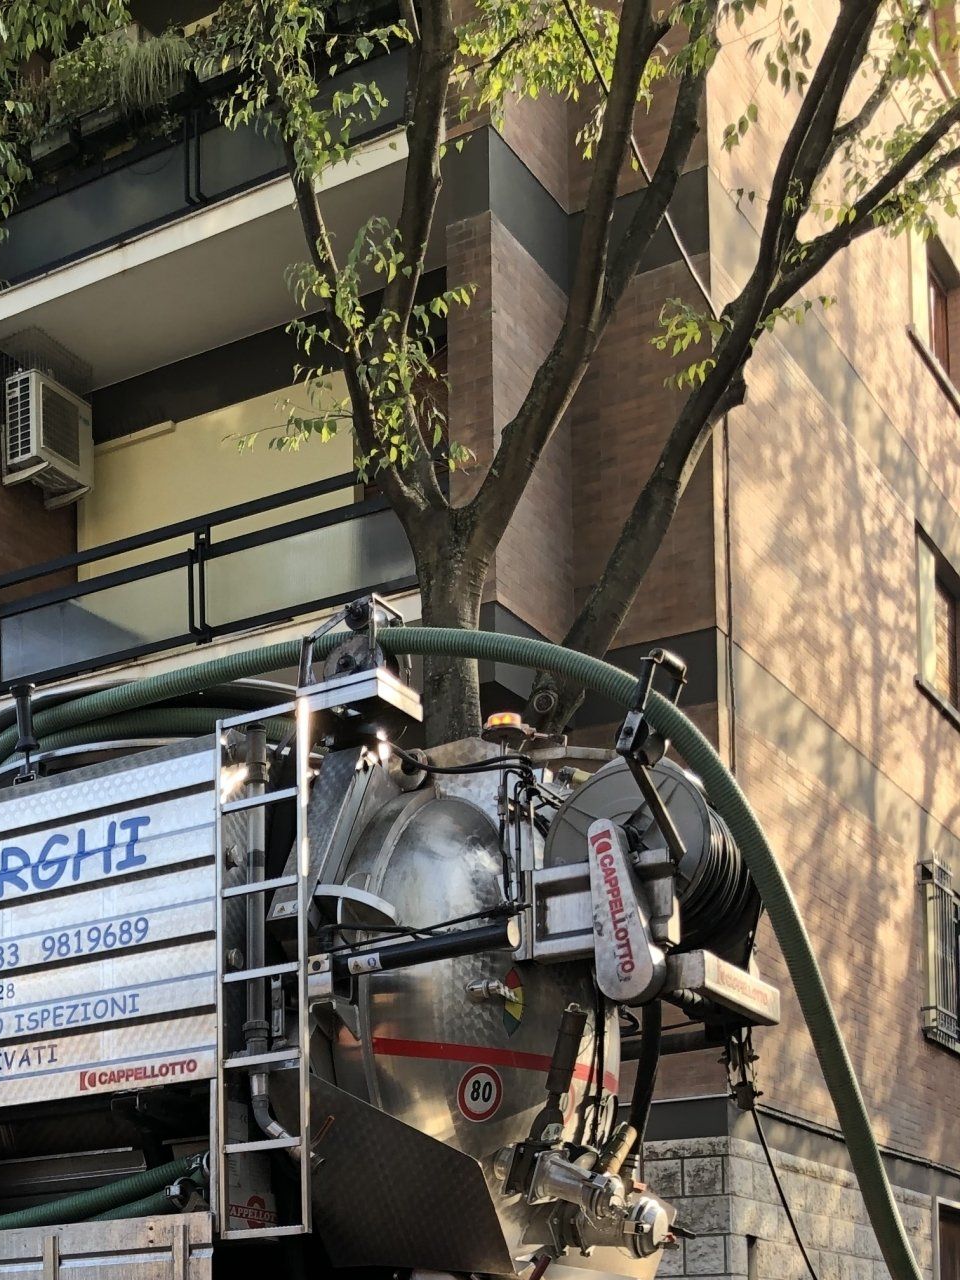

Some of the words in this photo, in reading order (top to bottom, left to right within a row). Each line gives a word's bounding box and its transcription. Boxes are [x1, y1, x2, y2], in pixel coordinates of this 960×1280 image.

[599, 854, 636, 974] CAPPELLOTTO
[41, 916, 150, 962] 9819689
[14, 992, 140, 1034] ISPEZIONI
[98, 1058, 198, 1086] CAPPELLOTTO
[470, 1079, 493, 1103] 80
